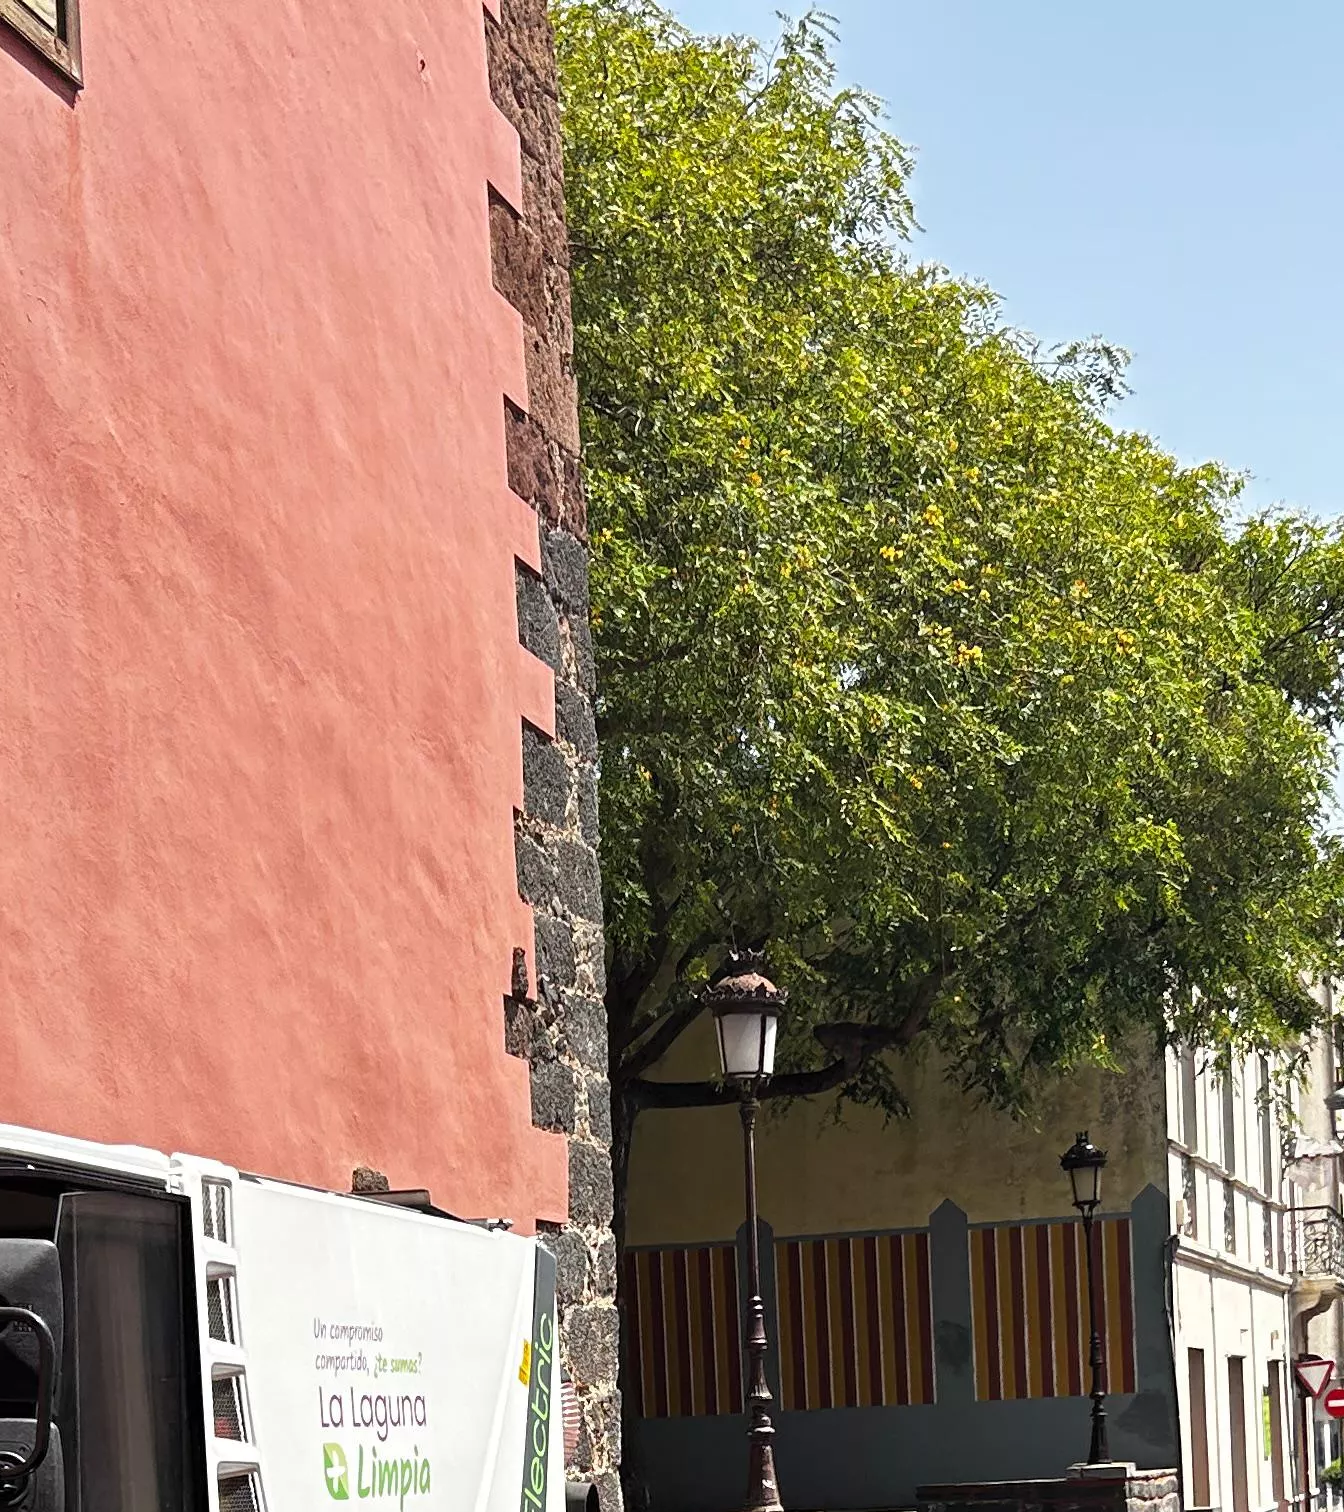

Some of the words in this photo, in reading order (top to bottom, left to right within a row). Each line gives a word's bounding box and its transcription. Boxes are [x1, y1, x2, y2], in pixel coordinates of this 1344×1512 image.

[313, 1317, 327, 1339] Un
[329, 1321, 383, 1348] compromiso
[315, 1348, 370, 1378] compartido,
[390, 1351, 423, 1376] sumas?
[318, 1385, 345, 1428] La
[350, 1385, 428, 1442] Laguna
